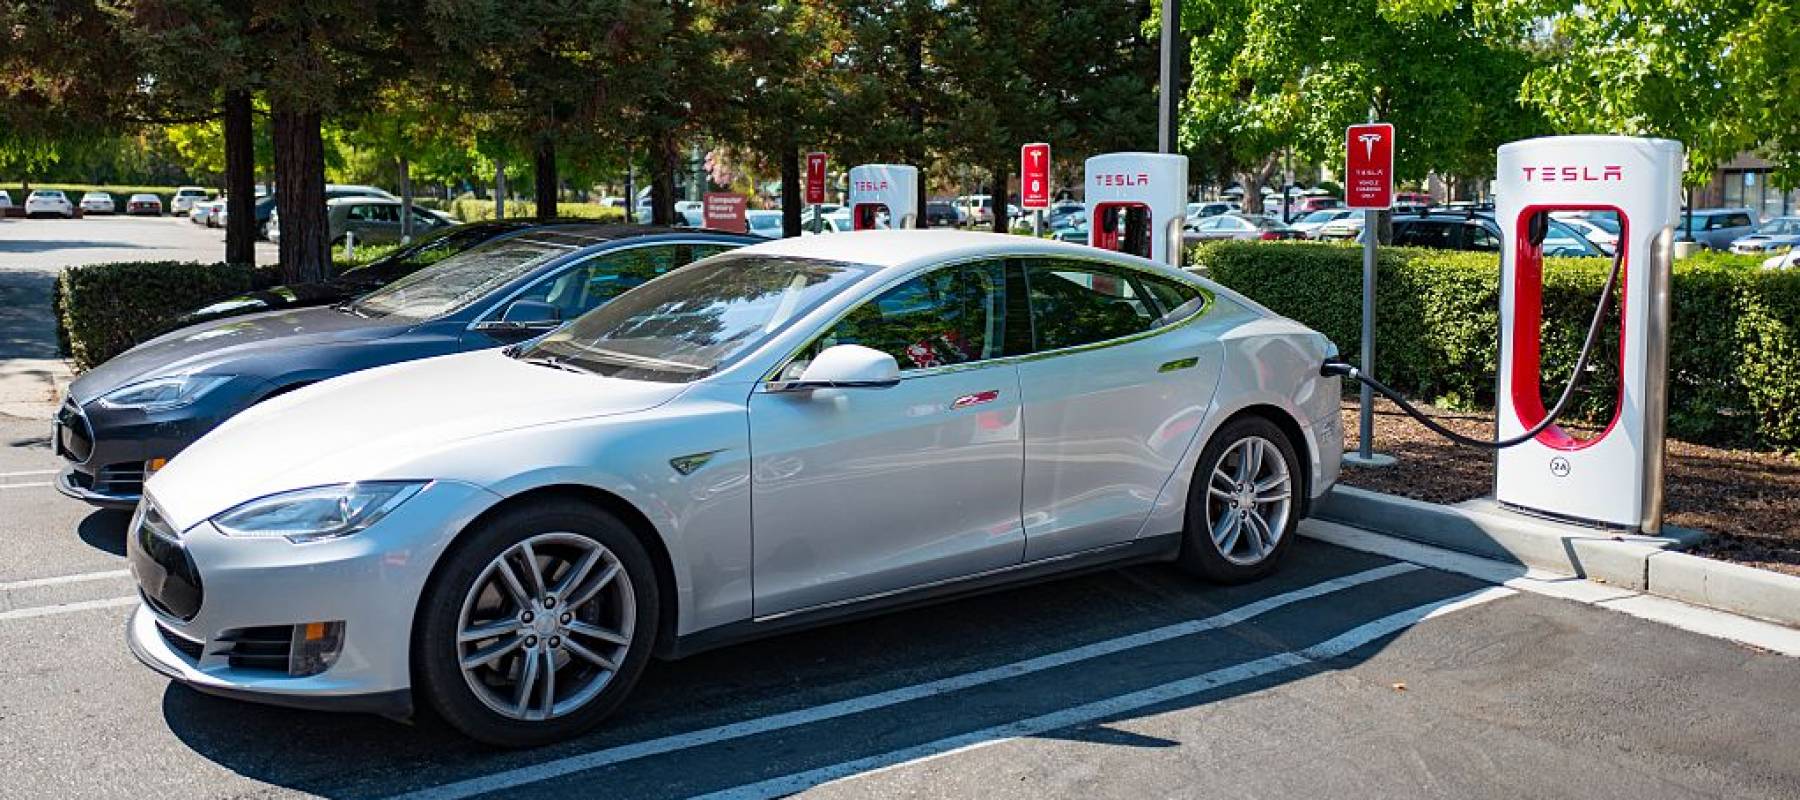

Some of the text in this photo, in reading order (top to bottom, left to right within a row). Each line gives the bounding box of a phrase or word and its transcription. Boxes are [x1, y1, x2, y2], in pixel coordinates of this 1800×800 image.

[1522, 165, 1622, 182] TESLA
[1095, 174, 1149, 186] TESLA
[855, 181, 889, 192] TESLA
[709, 195, 742, 205] Computer
[1554, 462, 1567, 471] 2A
